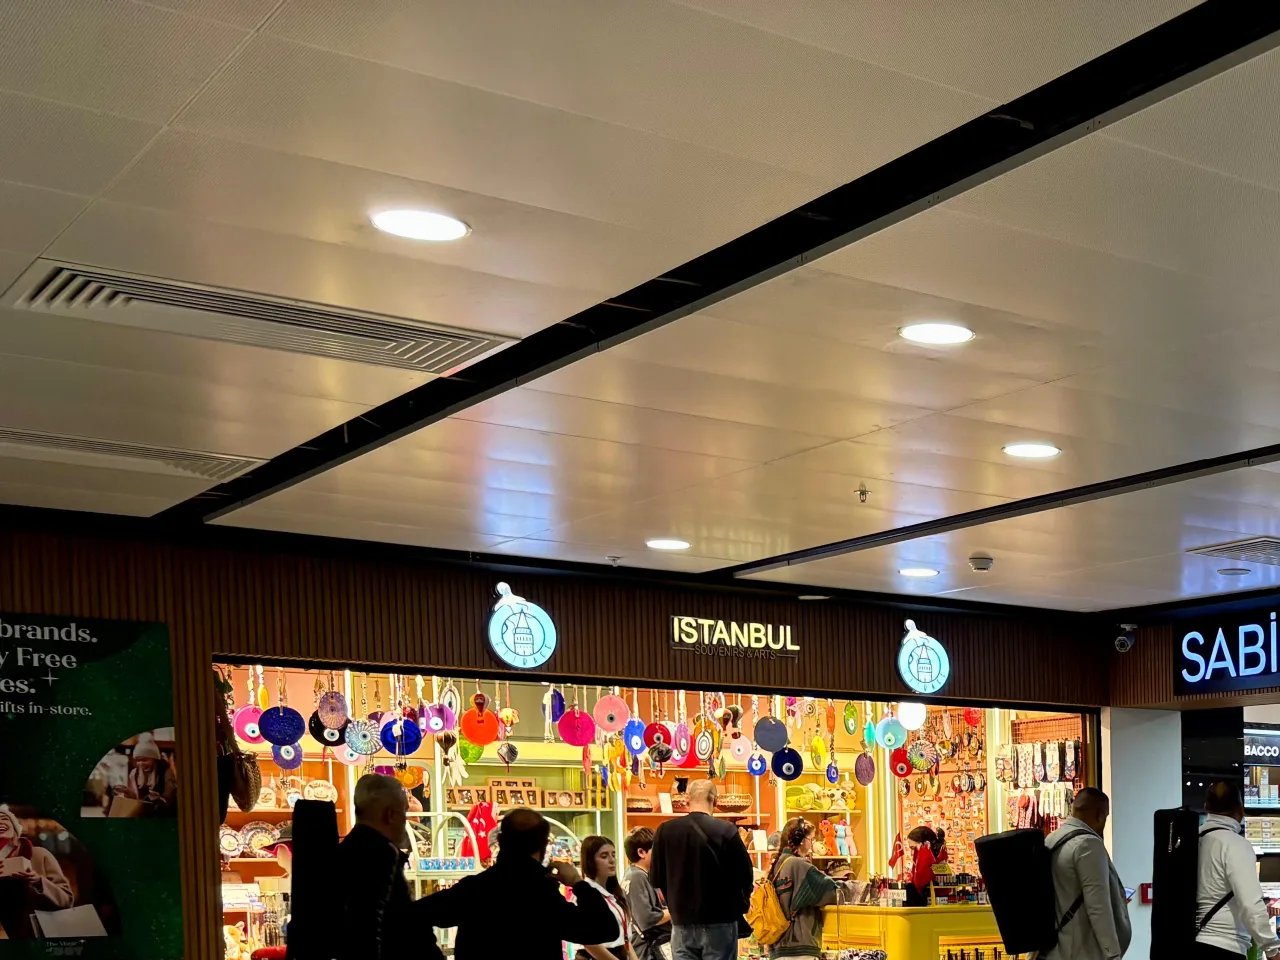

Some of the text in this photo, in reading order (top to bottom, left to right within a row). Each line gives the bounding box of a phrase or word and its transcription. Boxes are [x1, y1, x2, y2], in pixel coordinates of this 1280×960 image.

[17, 647, 77, 669] Free
[694, 644, 745, 658] SOUVENIRS
[754, 650, 776, 660] ARTS
[29, 701, 92, 716] in-store.
